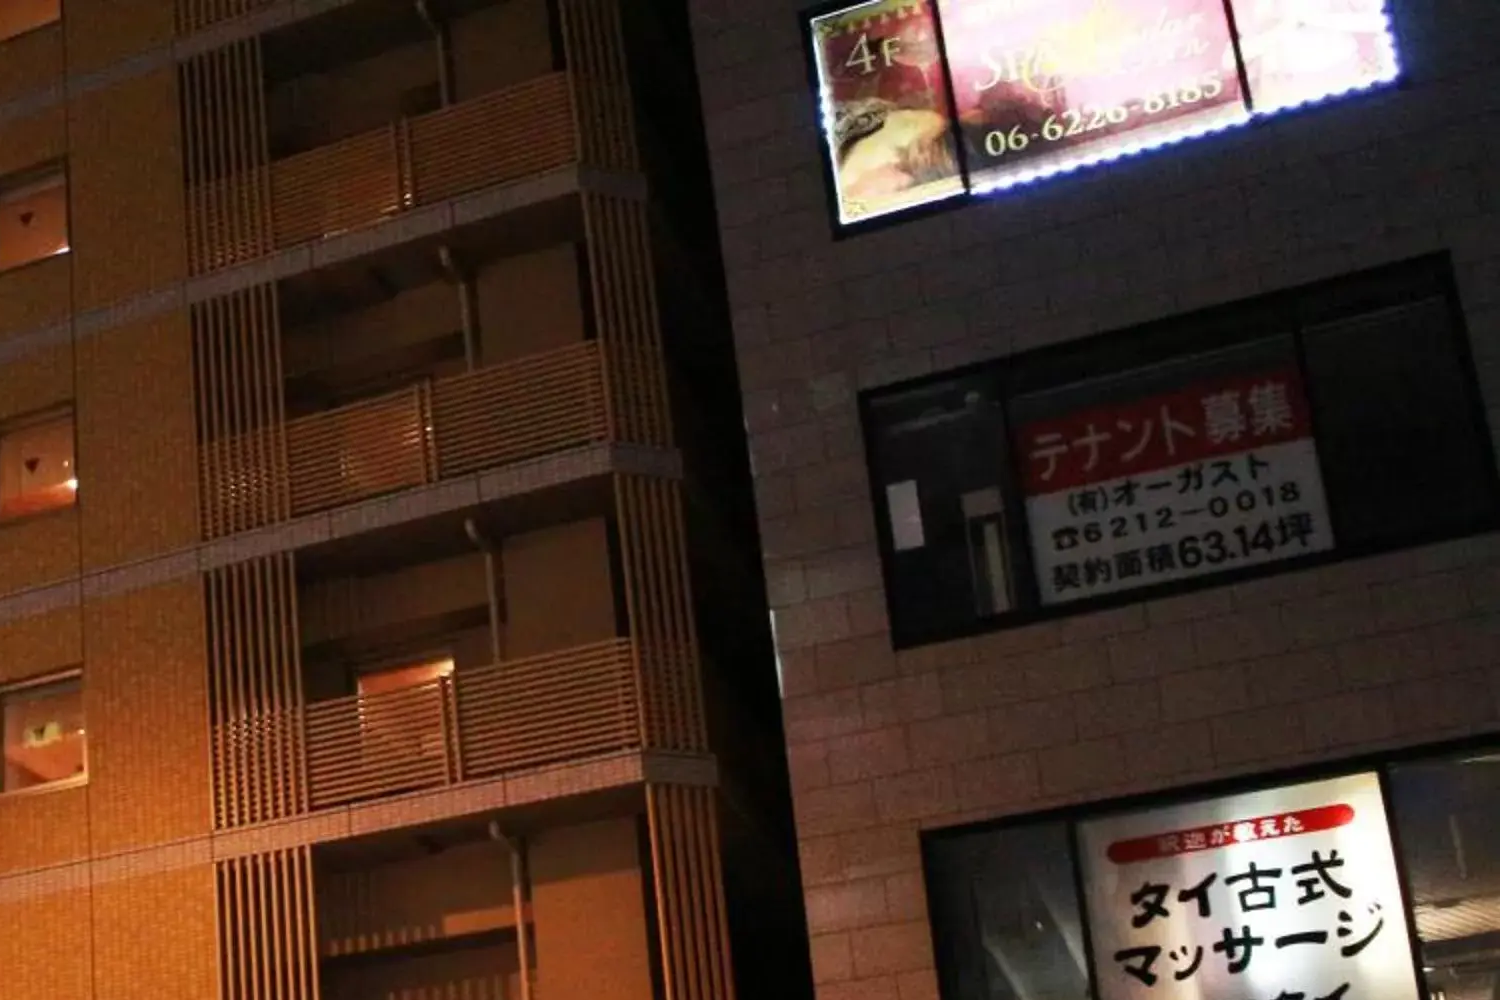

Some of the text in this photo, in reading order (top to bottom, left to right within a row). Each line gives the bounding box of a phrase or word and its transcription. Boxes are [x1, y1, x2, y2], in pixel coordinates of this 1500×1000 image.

[845, 33, 901, 75] 4F
[1028, 381, 1296, 482] テナント募集
[1130, 850, 1353, 929] タイ古式
[1114, 902, 1385, 986] マッサージ
